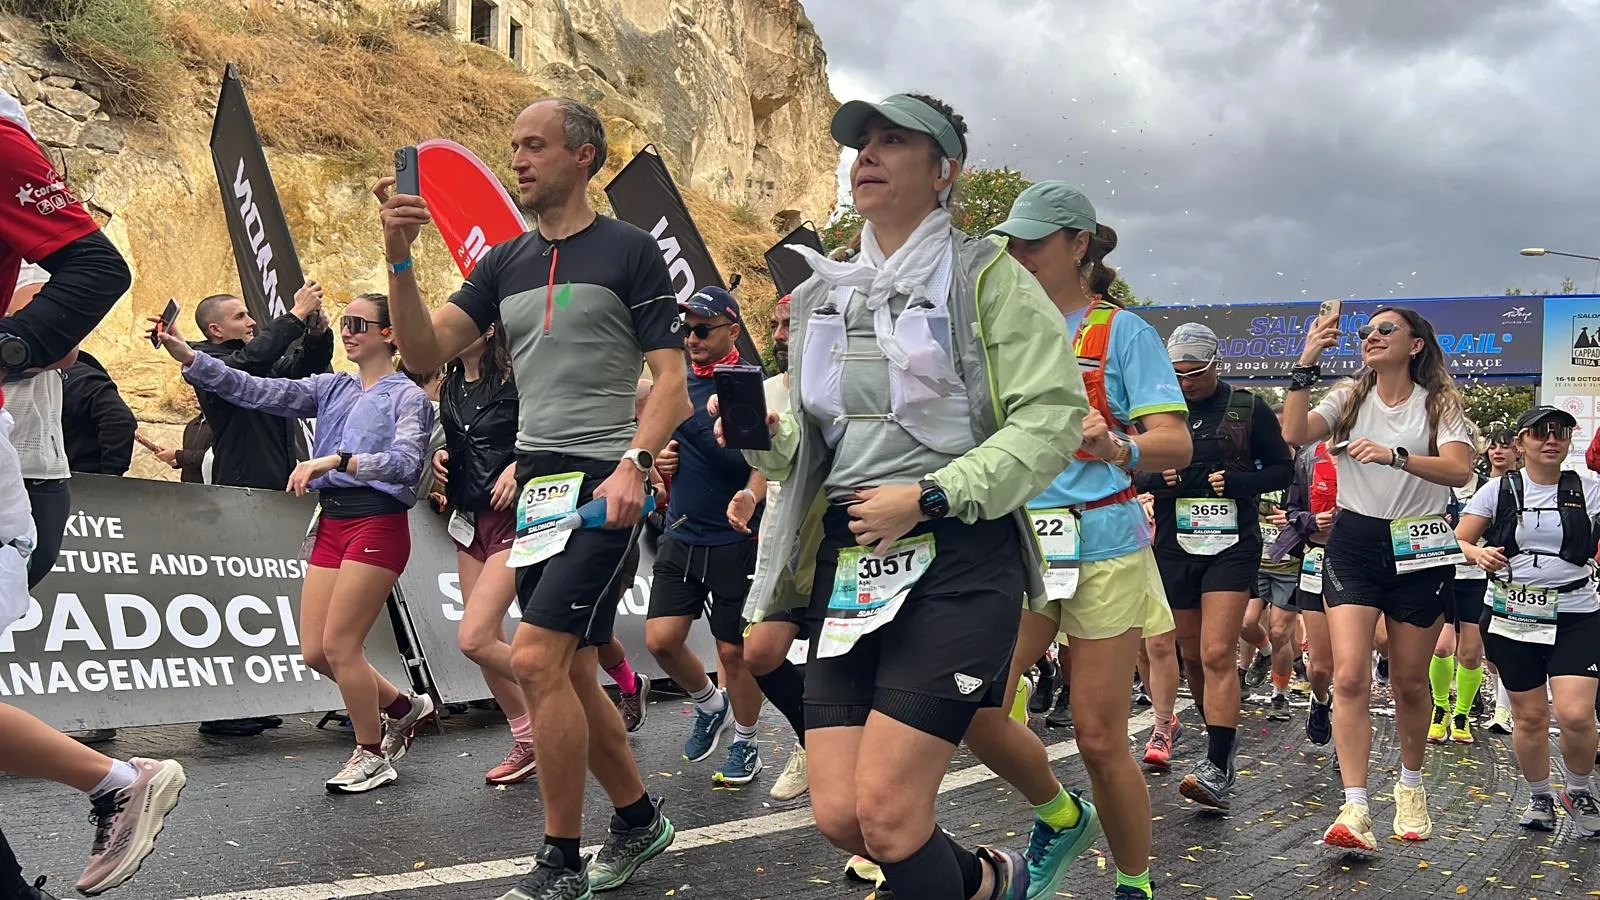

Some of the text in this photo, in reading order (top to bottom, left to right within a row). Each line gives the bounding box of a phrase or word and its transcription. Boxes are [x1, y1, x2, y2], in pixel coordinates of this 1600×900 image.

[1436, 333, 1503, 354] RAIL
[1574, 348, 1600, 358] CAPPAD
[1236, 361, 1269, 370] 2026
[1191, 504, 1229, 516] 3655
[63, 510, 125, 539] KİYE
[1035, 518, 1064, 537] 22
[1260, 526, 1278, 536] 353
[1409, 522, 1448, 538] 3260
[50, 549, 140, 575] LTURE
[149, 553, 209, 577] AND
[1415, 550, 1446, 559] SALOMON
[858, 548, 916, 579] 3057
[1508, 589, 1548, 606] 3039
[0, 592, 300, 653] PADOCI
[1507, 615, 1538, 624] SALOMON
[245, 654, 321, 685] OFF
